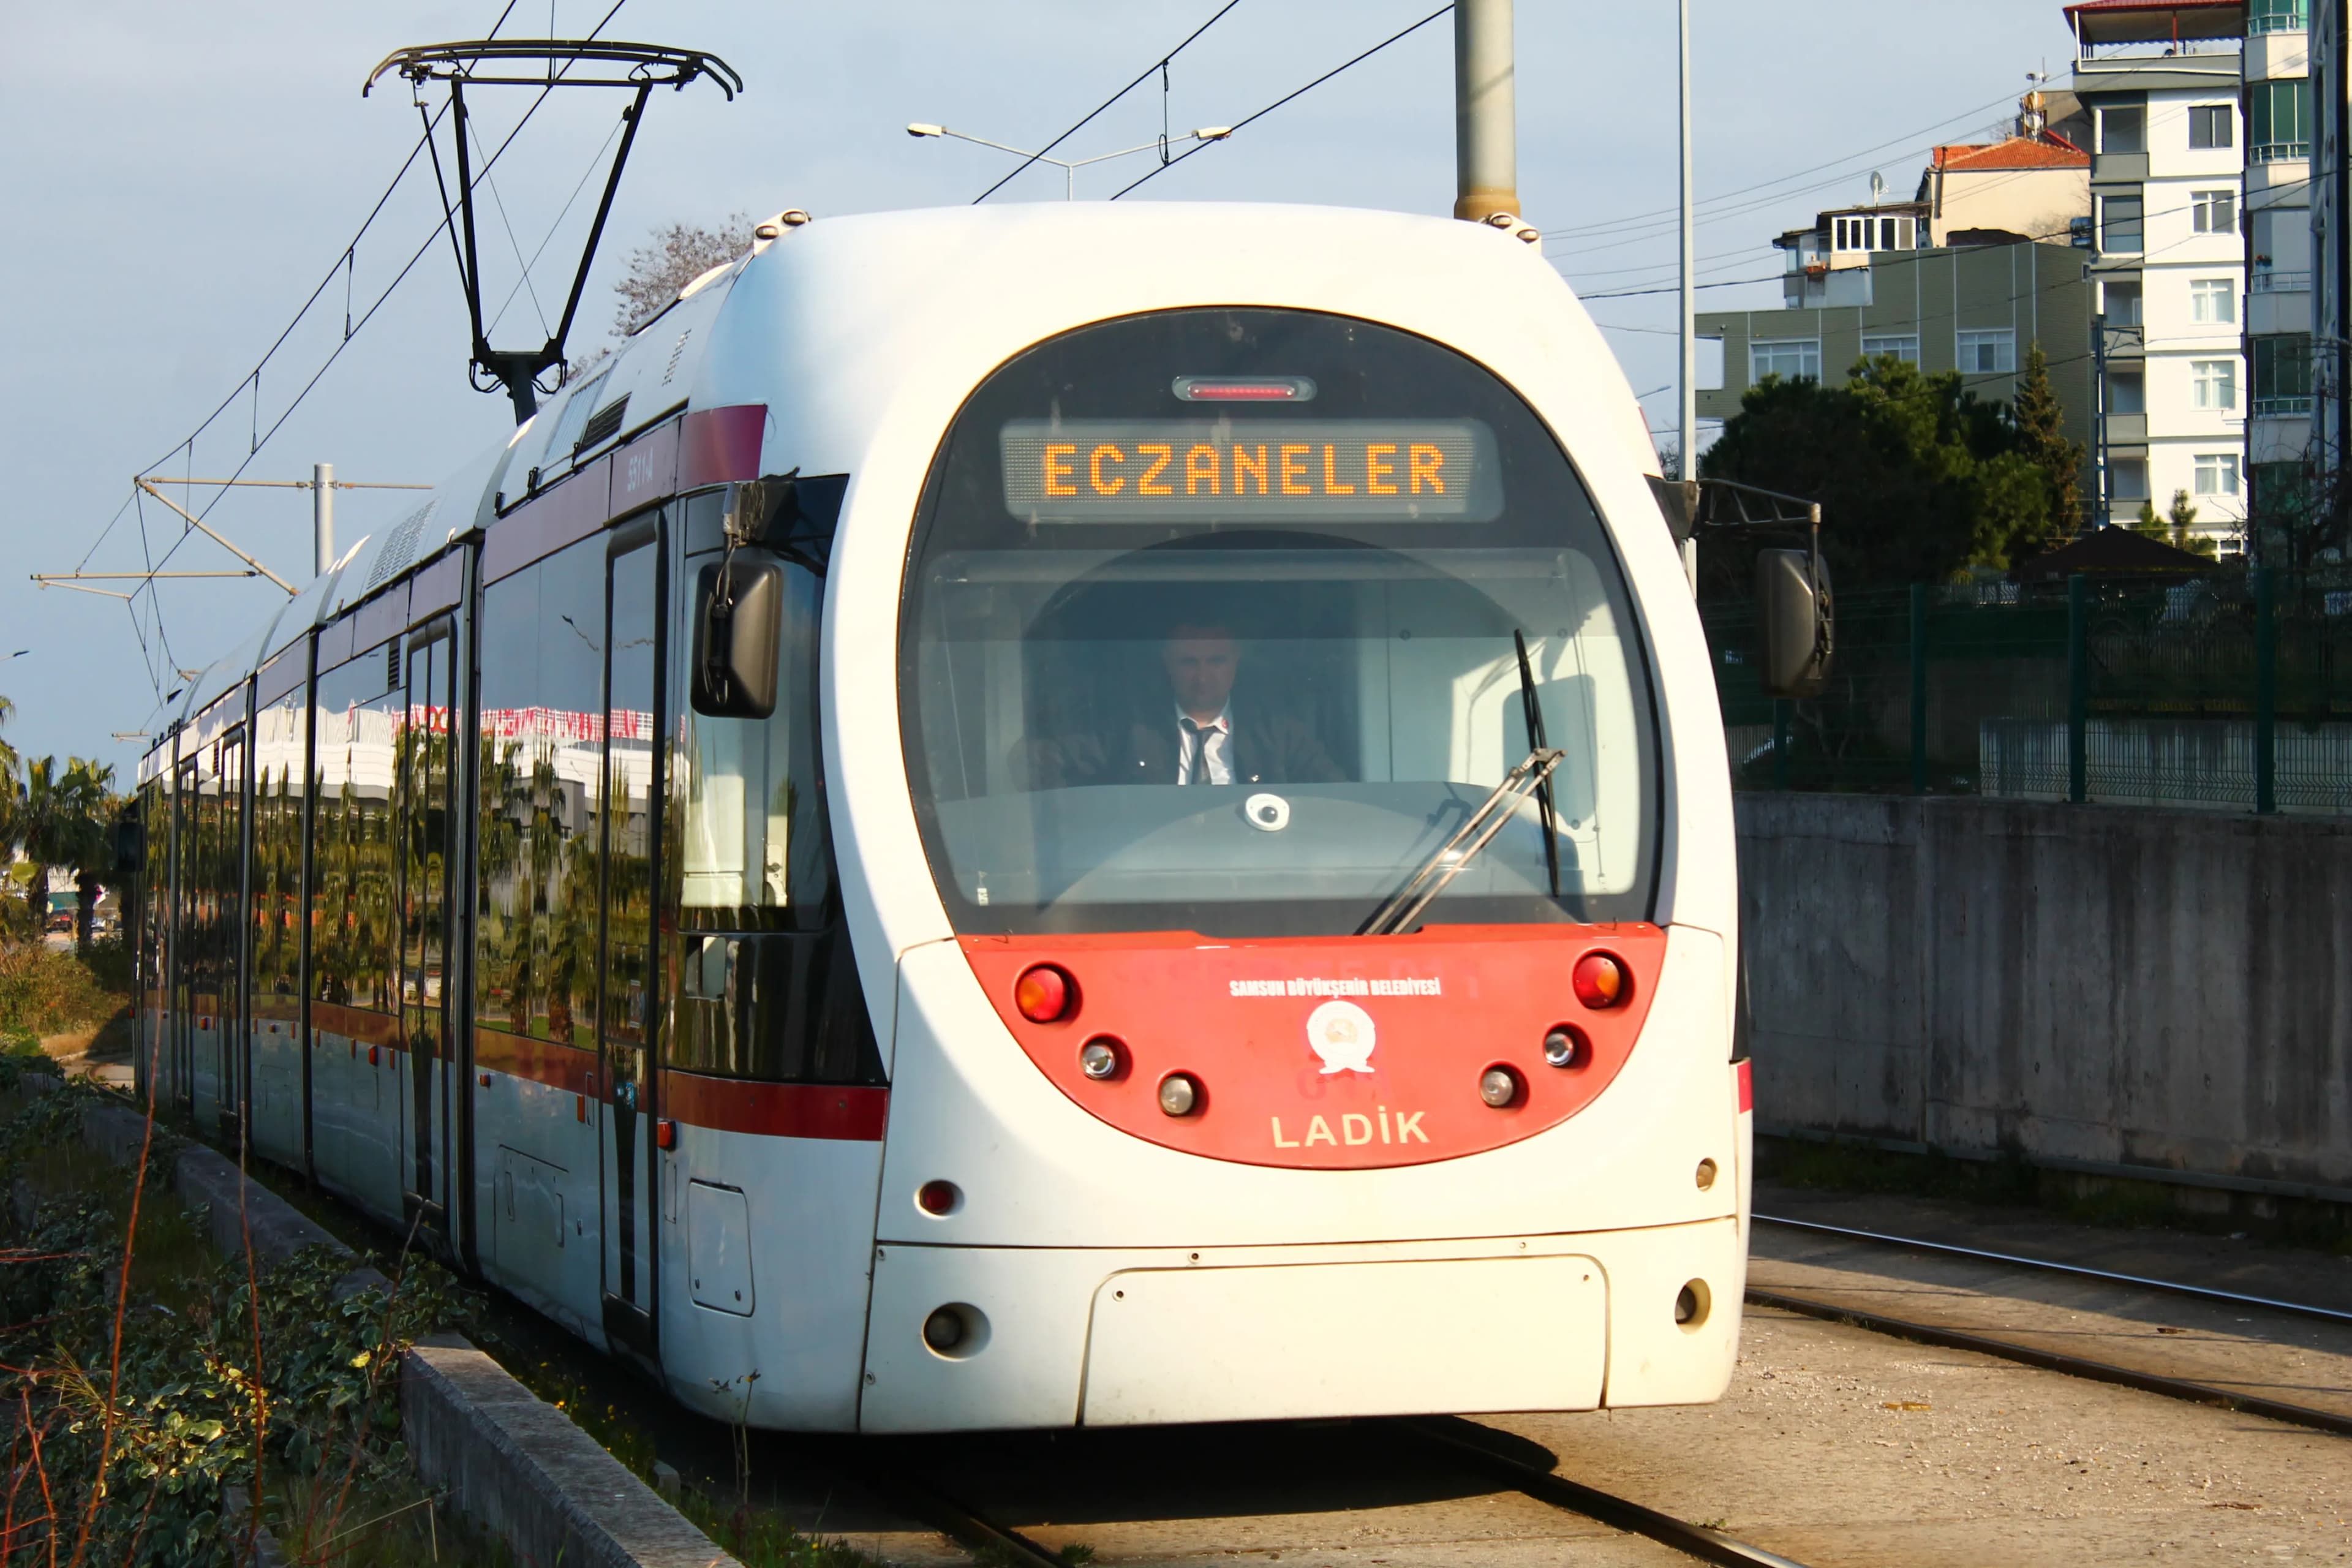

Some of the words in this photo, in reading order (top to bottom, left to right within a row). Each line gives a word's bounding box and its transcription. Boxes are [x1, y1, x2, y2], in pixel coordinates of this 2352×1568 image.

[1044, 444, 1445, 496] ECZANELER
[1229, 980, 1286, 996] SAMSUN
[1287, 978, 1369, 999] BÜYÜKŞEHİR
[1370, 977, 1441, 995] BELEDİYESİ
[1272, 1106, 1430, 1148] LADİK
